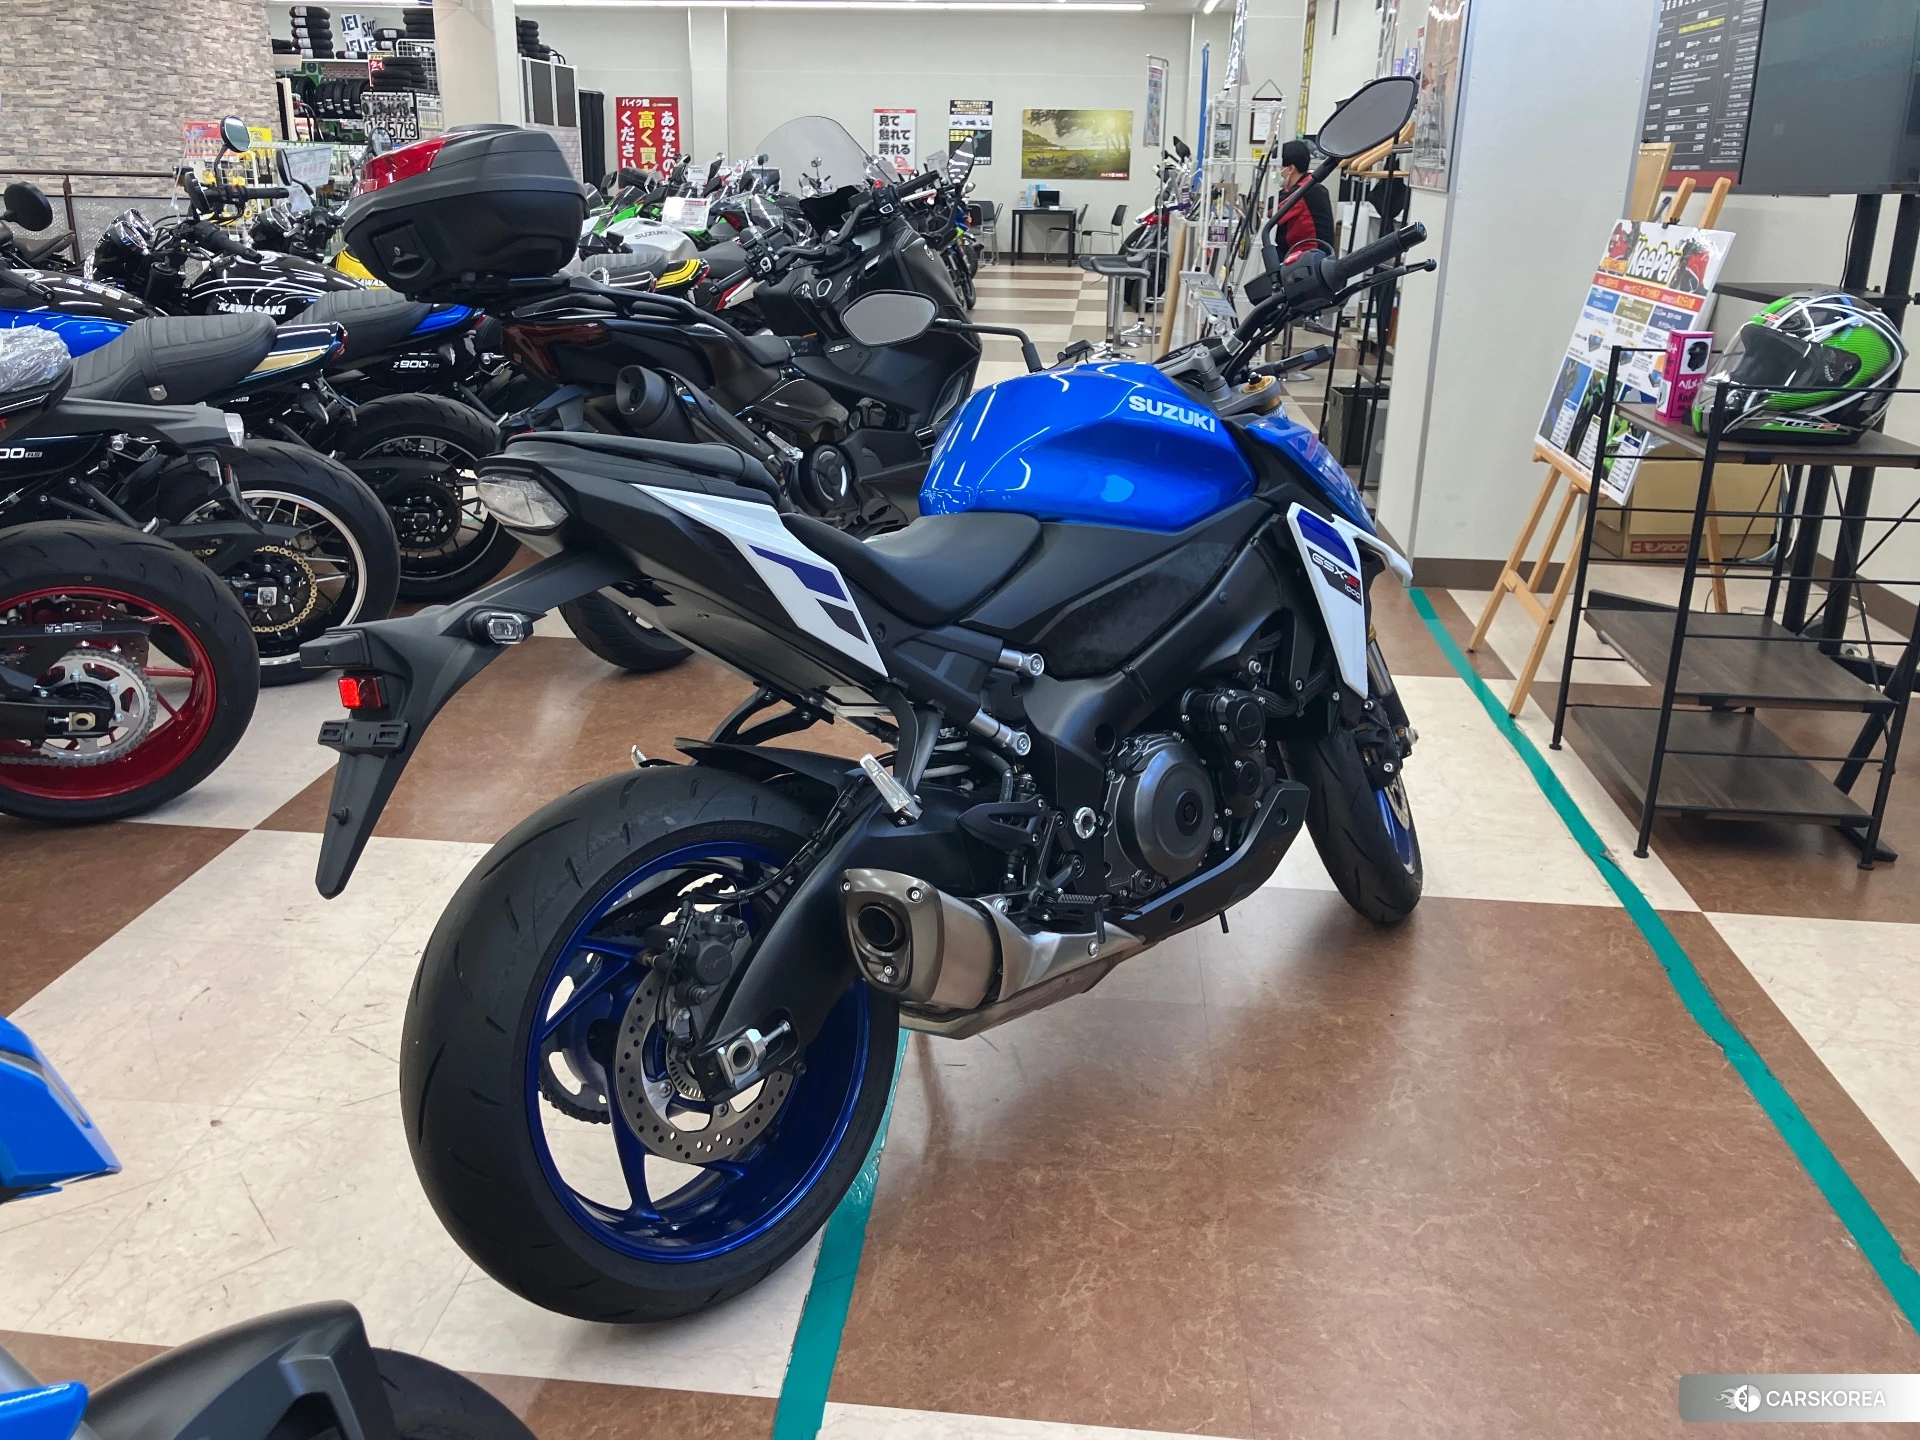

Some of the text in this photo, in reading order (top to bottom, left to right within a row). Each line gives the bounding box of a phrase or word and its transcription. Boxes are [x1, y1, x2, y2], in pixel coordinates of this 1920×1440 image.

[878, 115, 900, 127] 見て
[634, 230, 668, 240] SUZUKI
[217, 302, 287, 315] KAWASAKI
[1128, 395, 1216, 433] SUZUKI
[1312, 552, 1359, 588] GSX-S
[1344, 583, 1361, 599] 1000
